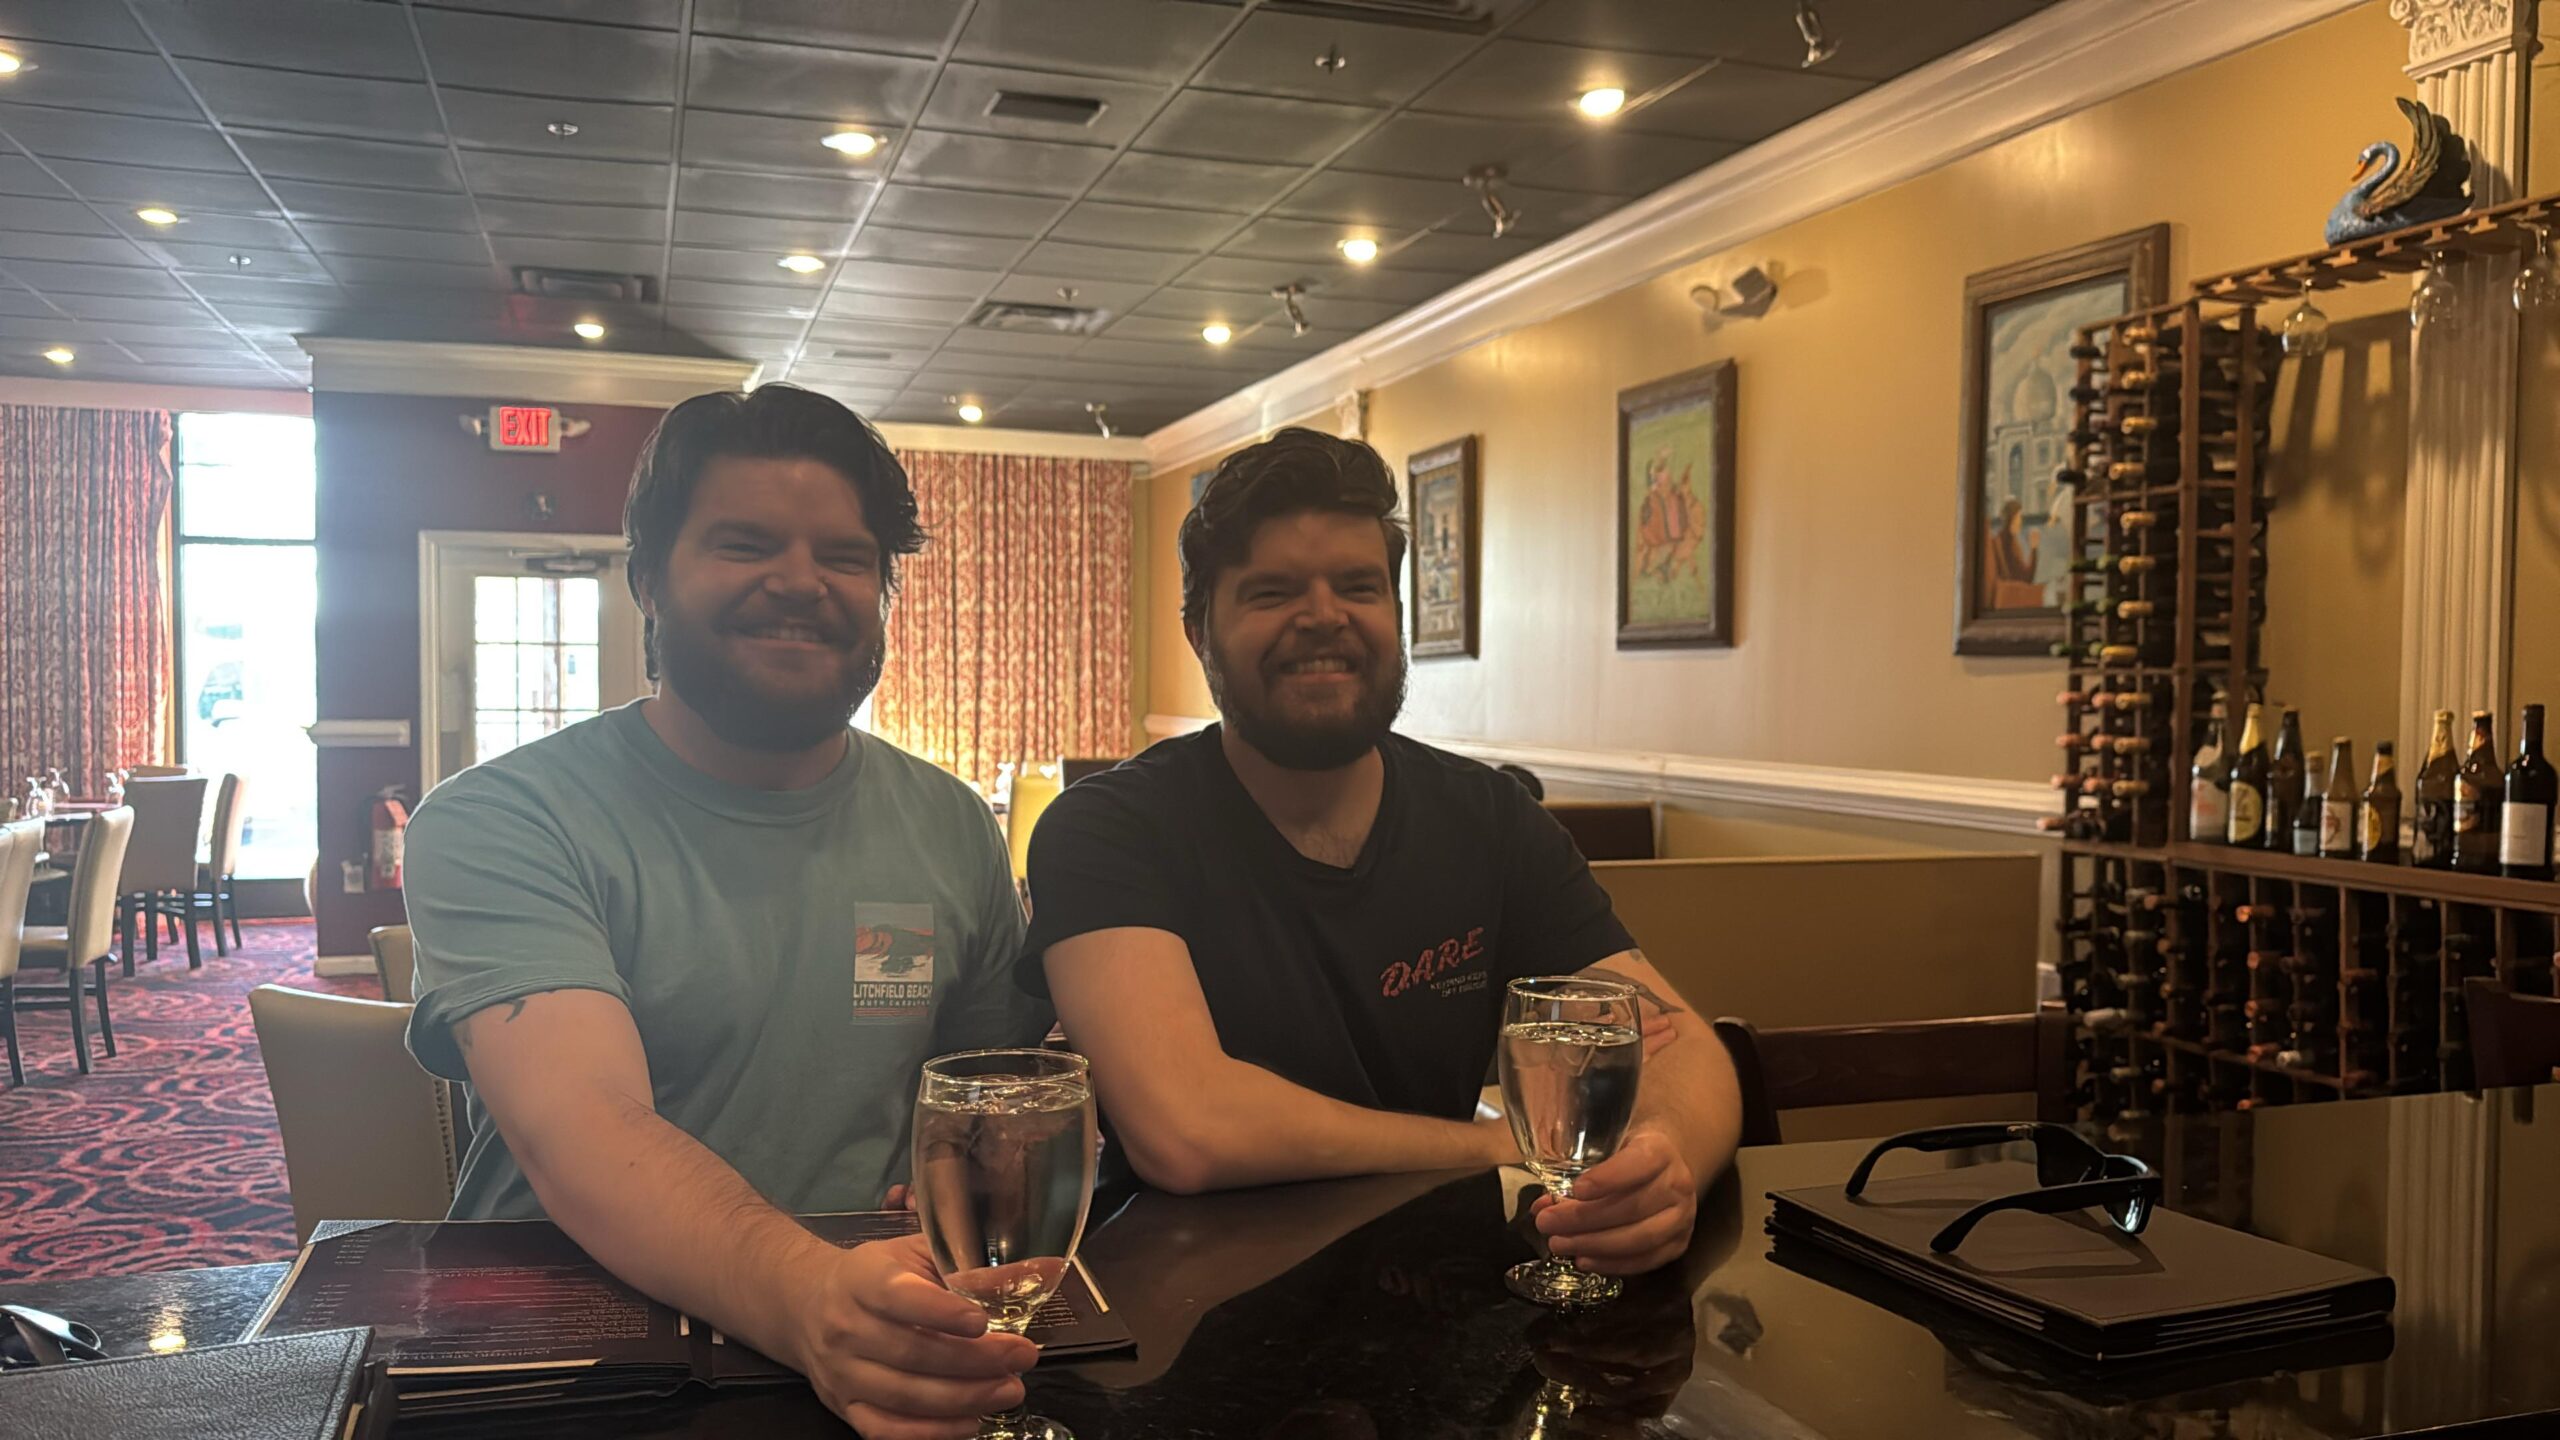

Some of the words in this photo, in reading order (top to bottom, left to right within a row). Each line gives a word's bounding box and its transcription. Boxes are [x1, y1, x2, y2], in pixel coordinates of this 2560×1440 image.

[500, 407, 551, 446] EXIT
[853, 983, 905, 999] LITCHFIELD
[906, 984, 933, 999] BEACH
